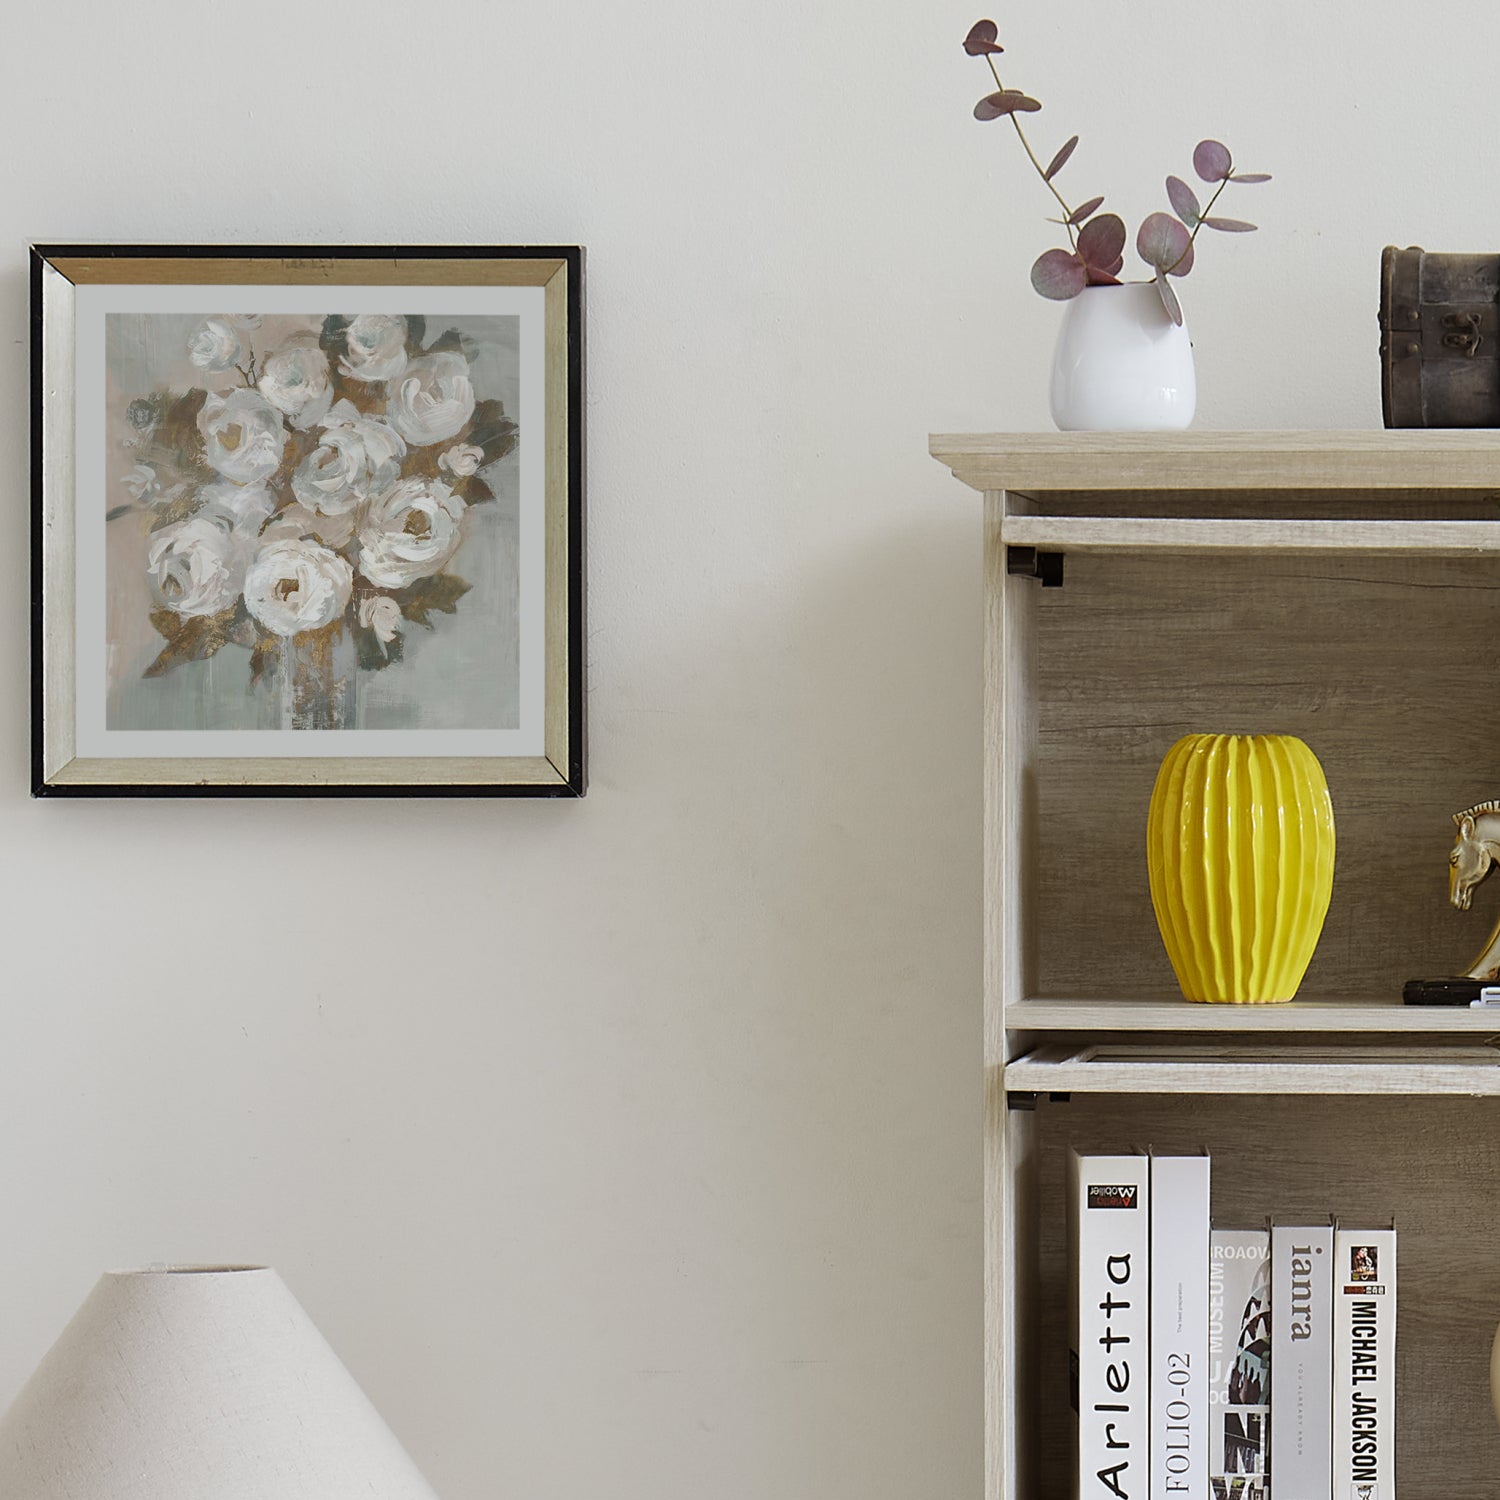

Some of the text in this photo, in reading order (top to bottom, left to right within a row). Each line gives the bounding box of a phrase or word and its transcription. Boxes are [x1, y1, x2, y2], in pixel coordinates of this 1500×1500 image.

[1291, 1244, 1323, 1342] ianra
[1094, 1252, 1132, 1500] Arletta
[1351, 1301, 1377, 1386] MICHAEL
[1165, 1352, 1191, 1493] FOLIO-02
[1351, 1391, 1377, 1481] JACKSON
